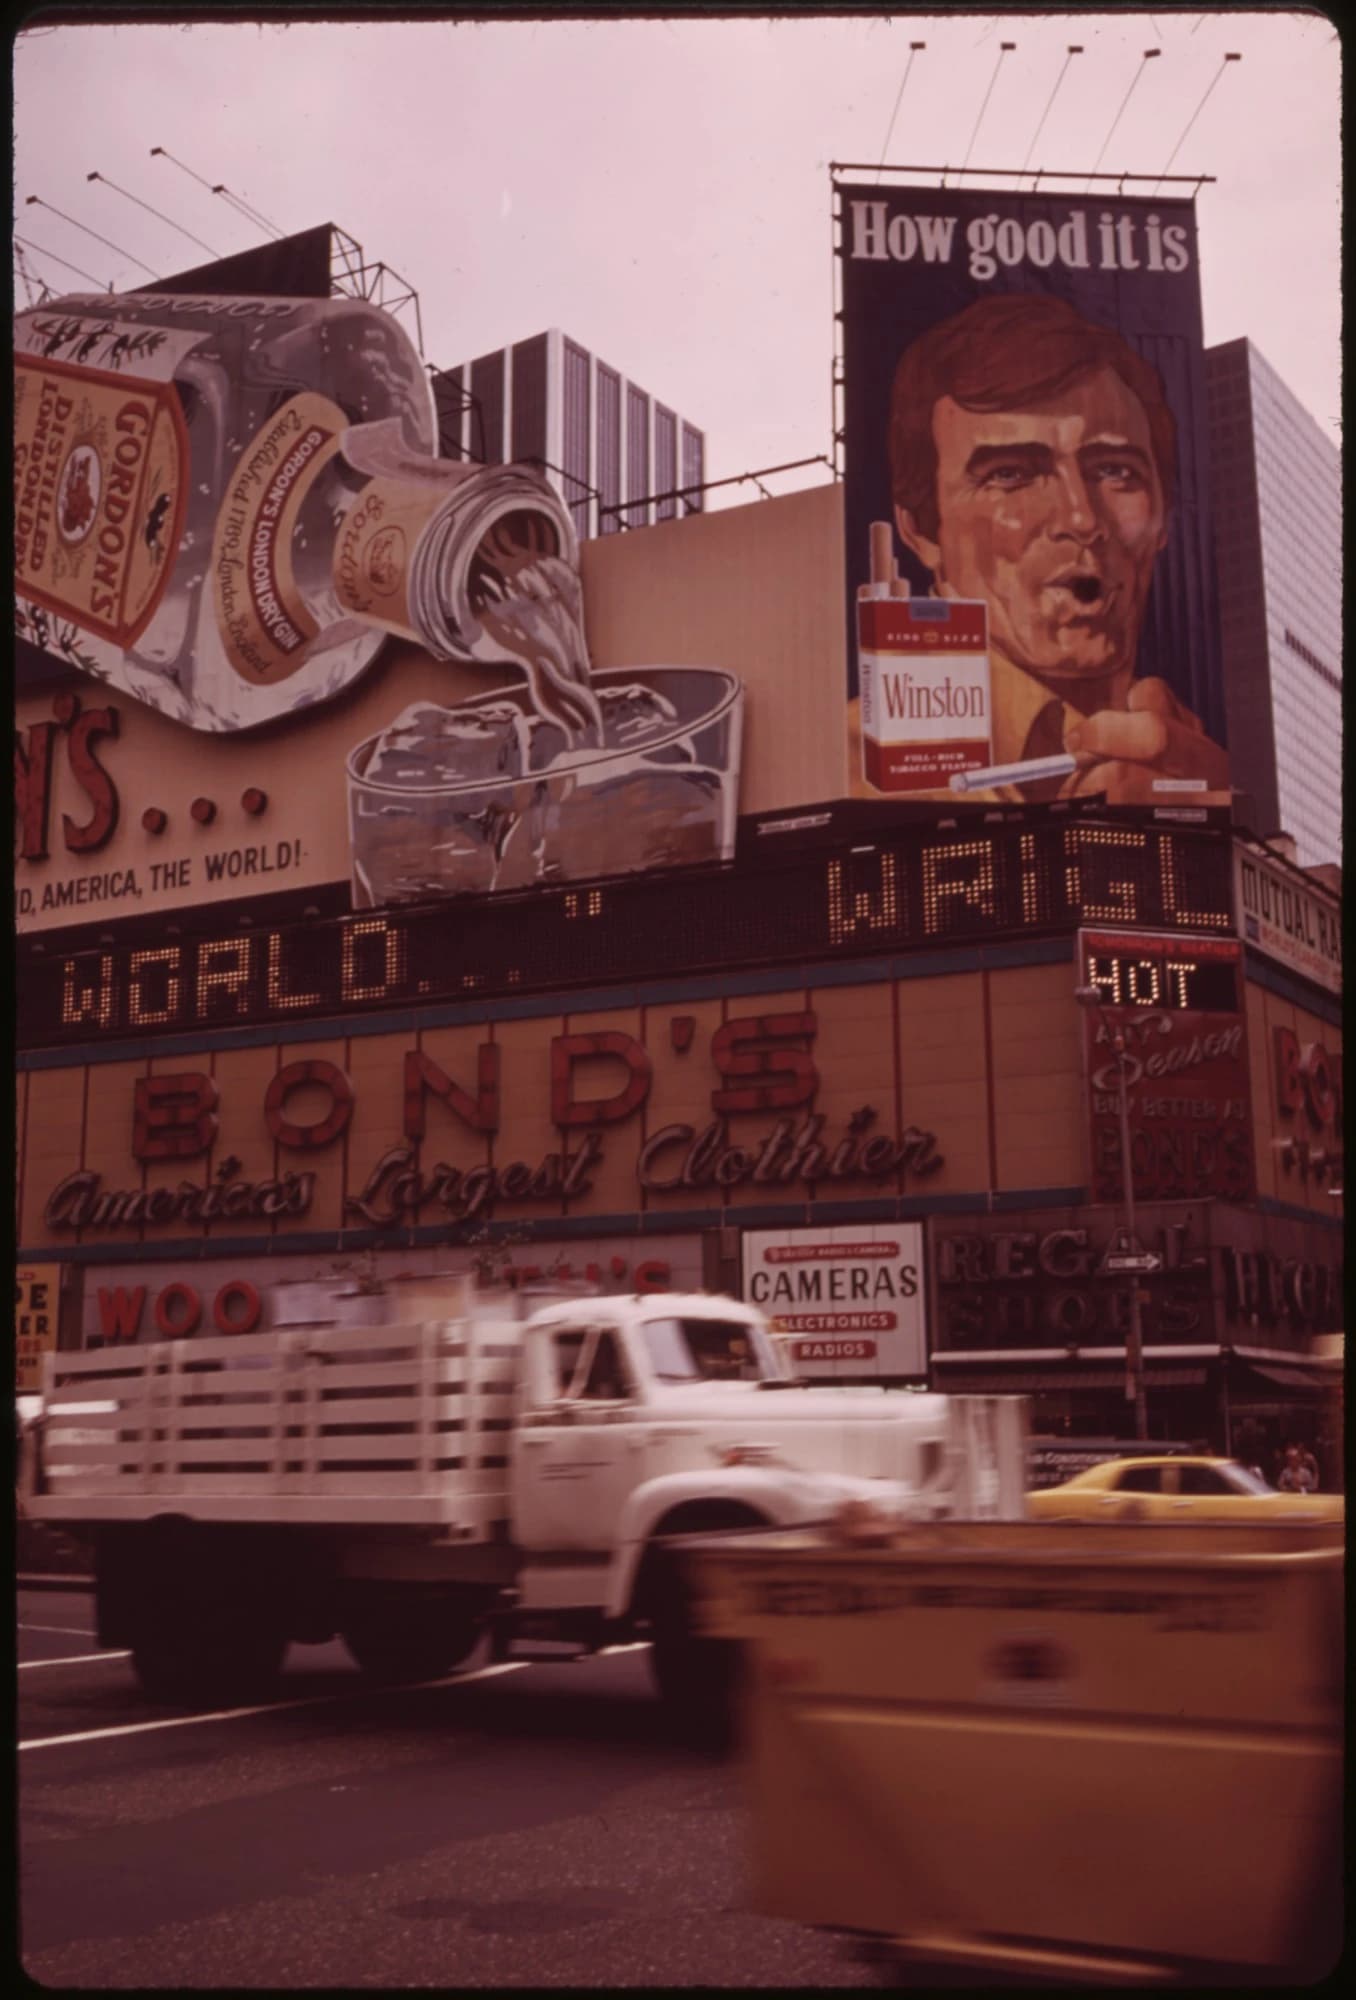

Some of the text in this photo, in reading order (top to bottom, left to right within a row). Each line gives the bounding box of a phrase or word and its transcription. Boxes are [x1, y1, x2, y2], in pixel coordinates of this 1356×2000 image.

[850, 200, 1190, 281] How good it is
[21, 378, 59, 509] LONDON
[30, 396, 73, 572] DISTILLED
[90, 401, 150, 619] GORDON'S
[252, 431, 322, 649] GORDON'S LONDON DRY GIN
[882, 672, 985, 720] Winston
[41, 870, 143, 912] AMERICA,
[151, 859, 192, 892] THE
[205, 839, 302, 882] WORLD!
[828, 827, 1230, 945] WRIGL
[1088, 956, 1197, 1009] HOT
[132, 1011, 820, 1163] BOND'S
[1142, 1096, 1217, 1119] BETTER
[45, 1105, 945, 1228] America's Largest Clothier
[751, 1265, 918, 1303] CAMERAS
[801, 1342, 866, 1357] RADIOS
